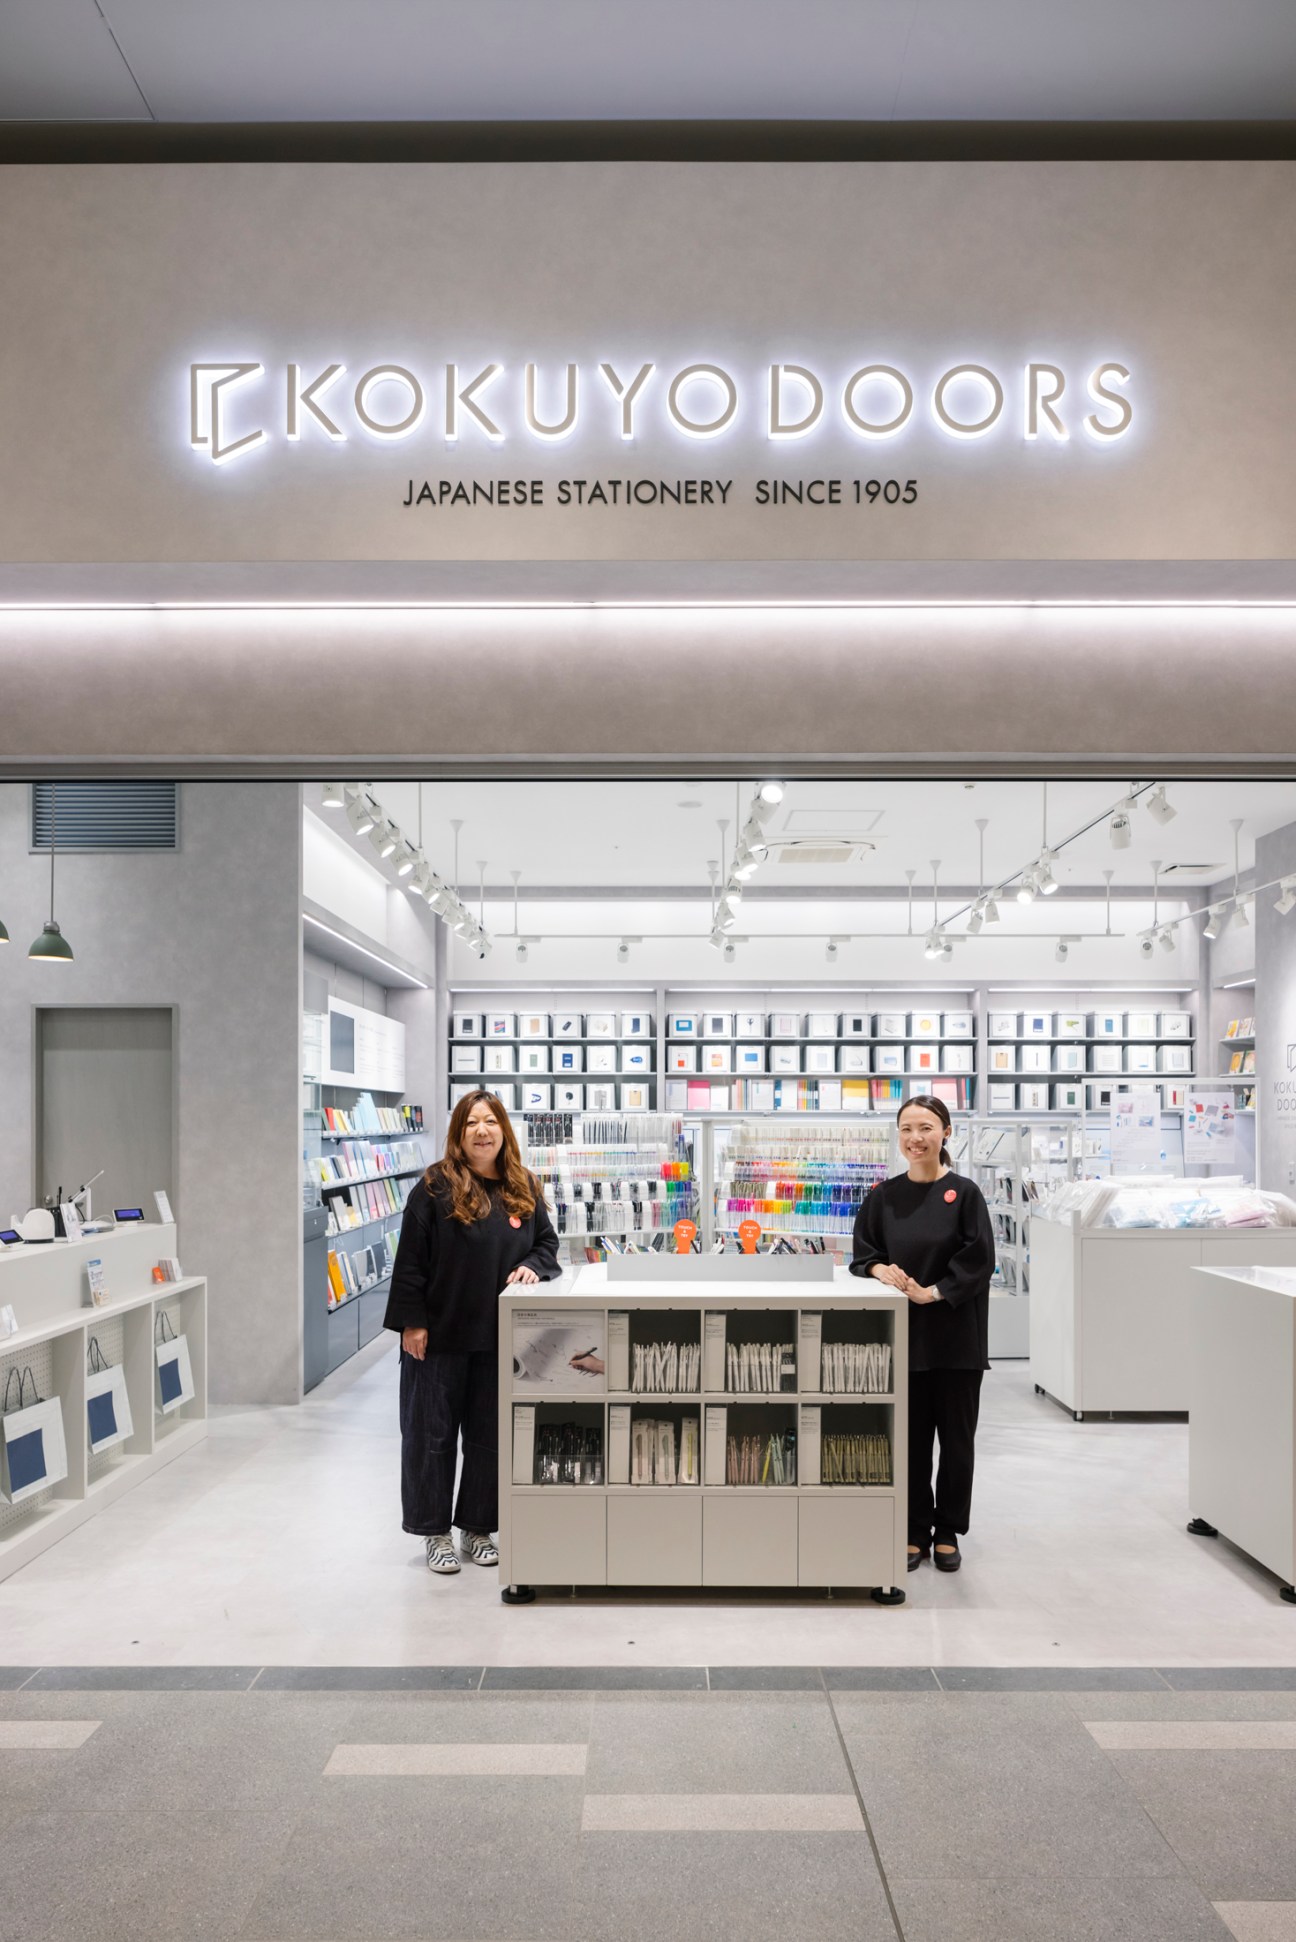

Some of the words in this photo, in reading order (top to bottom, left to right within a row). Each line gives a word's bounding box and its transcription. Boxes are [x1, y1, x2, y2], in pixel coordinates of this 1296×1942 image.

[286, 363, 738, 441] KOKUYO
[768, 362, 1133, 441] DOORS
[403, 479, 544, 506] JAPANESE
[557, 479, 733, 505] STATIONERY
[755, 479, 842, 505] SINCE
[852, 479, 918, 505] 1905
